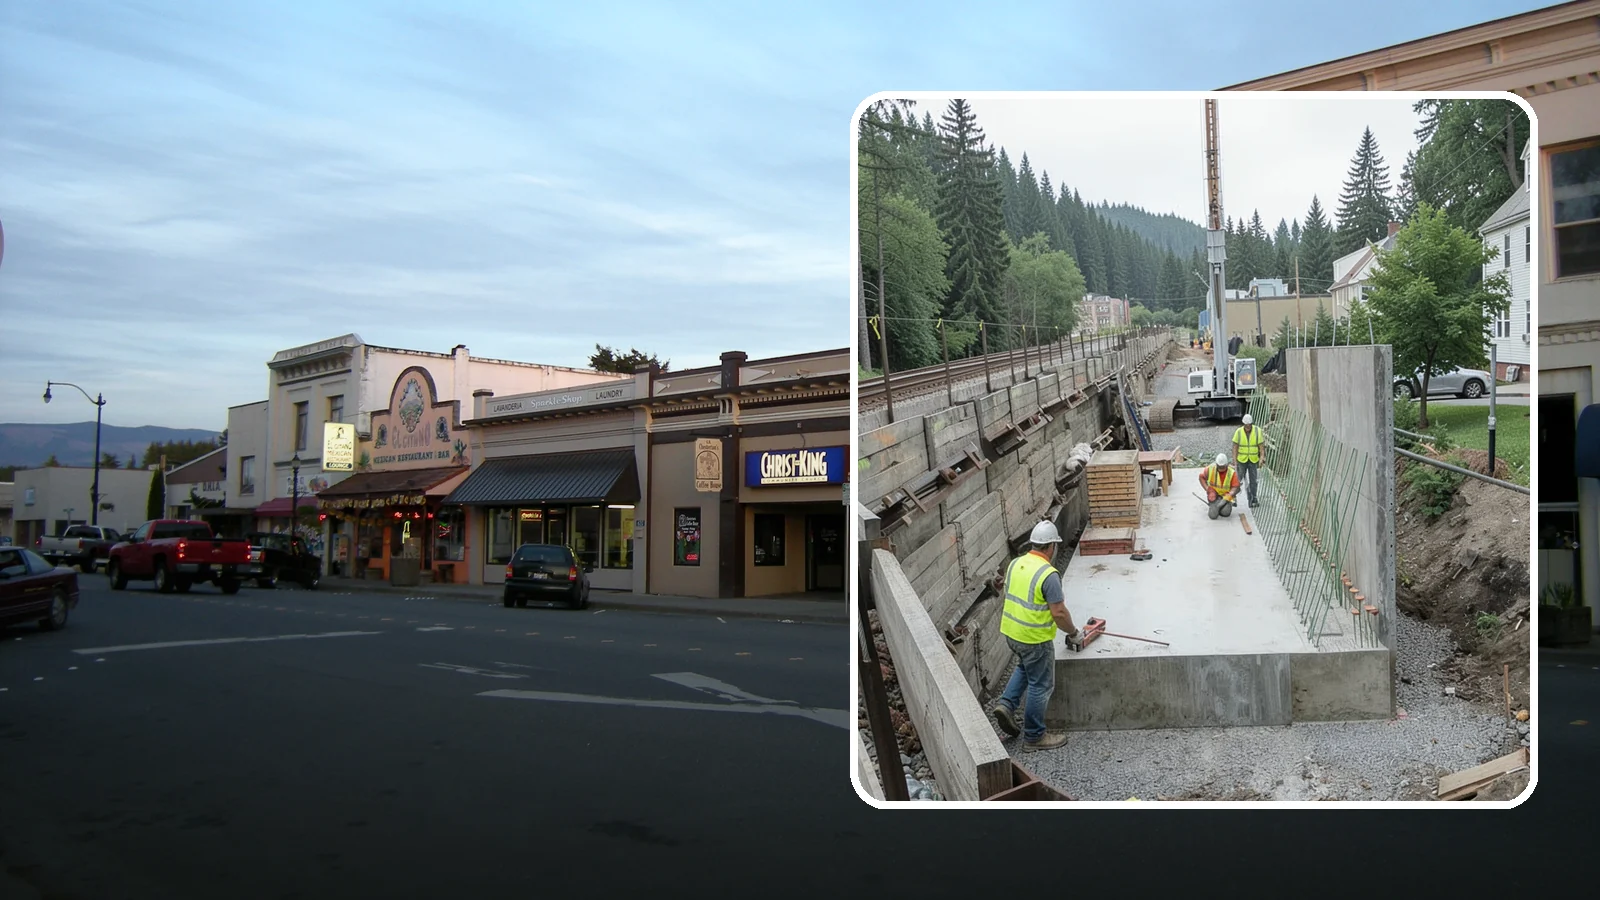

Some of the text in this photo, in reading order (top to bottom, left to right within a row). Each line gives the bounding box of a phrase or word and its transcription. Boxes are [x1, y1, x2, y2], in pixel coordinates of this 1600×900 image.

[493, 402, 523, 413] LAVANDERIA
[561, 394, 583, 405] Shop
[595, 389, 624, 400] LAUNDRY
[373, 455, 396, 464] MEXICAN
[397, 451, 433, 462] RESTAURANT
[437, 450, 450, 459] BAR
[761, 450, 827, 478] CHRIST KING
